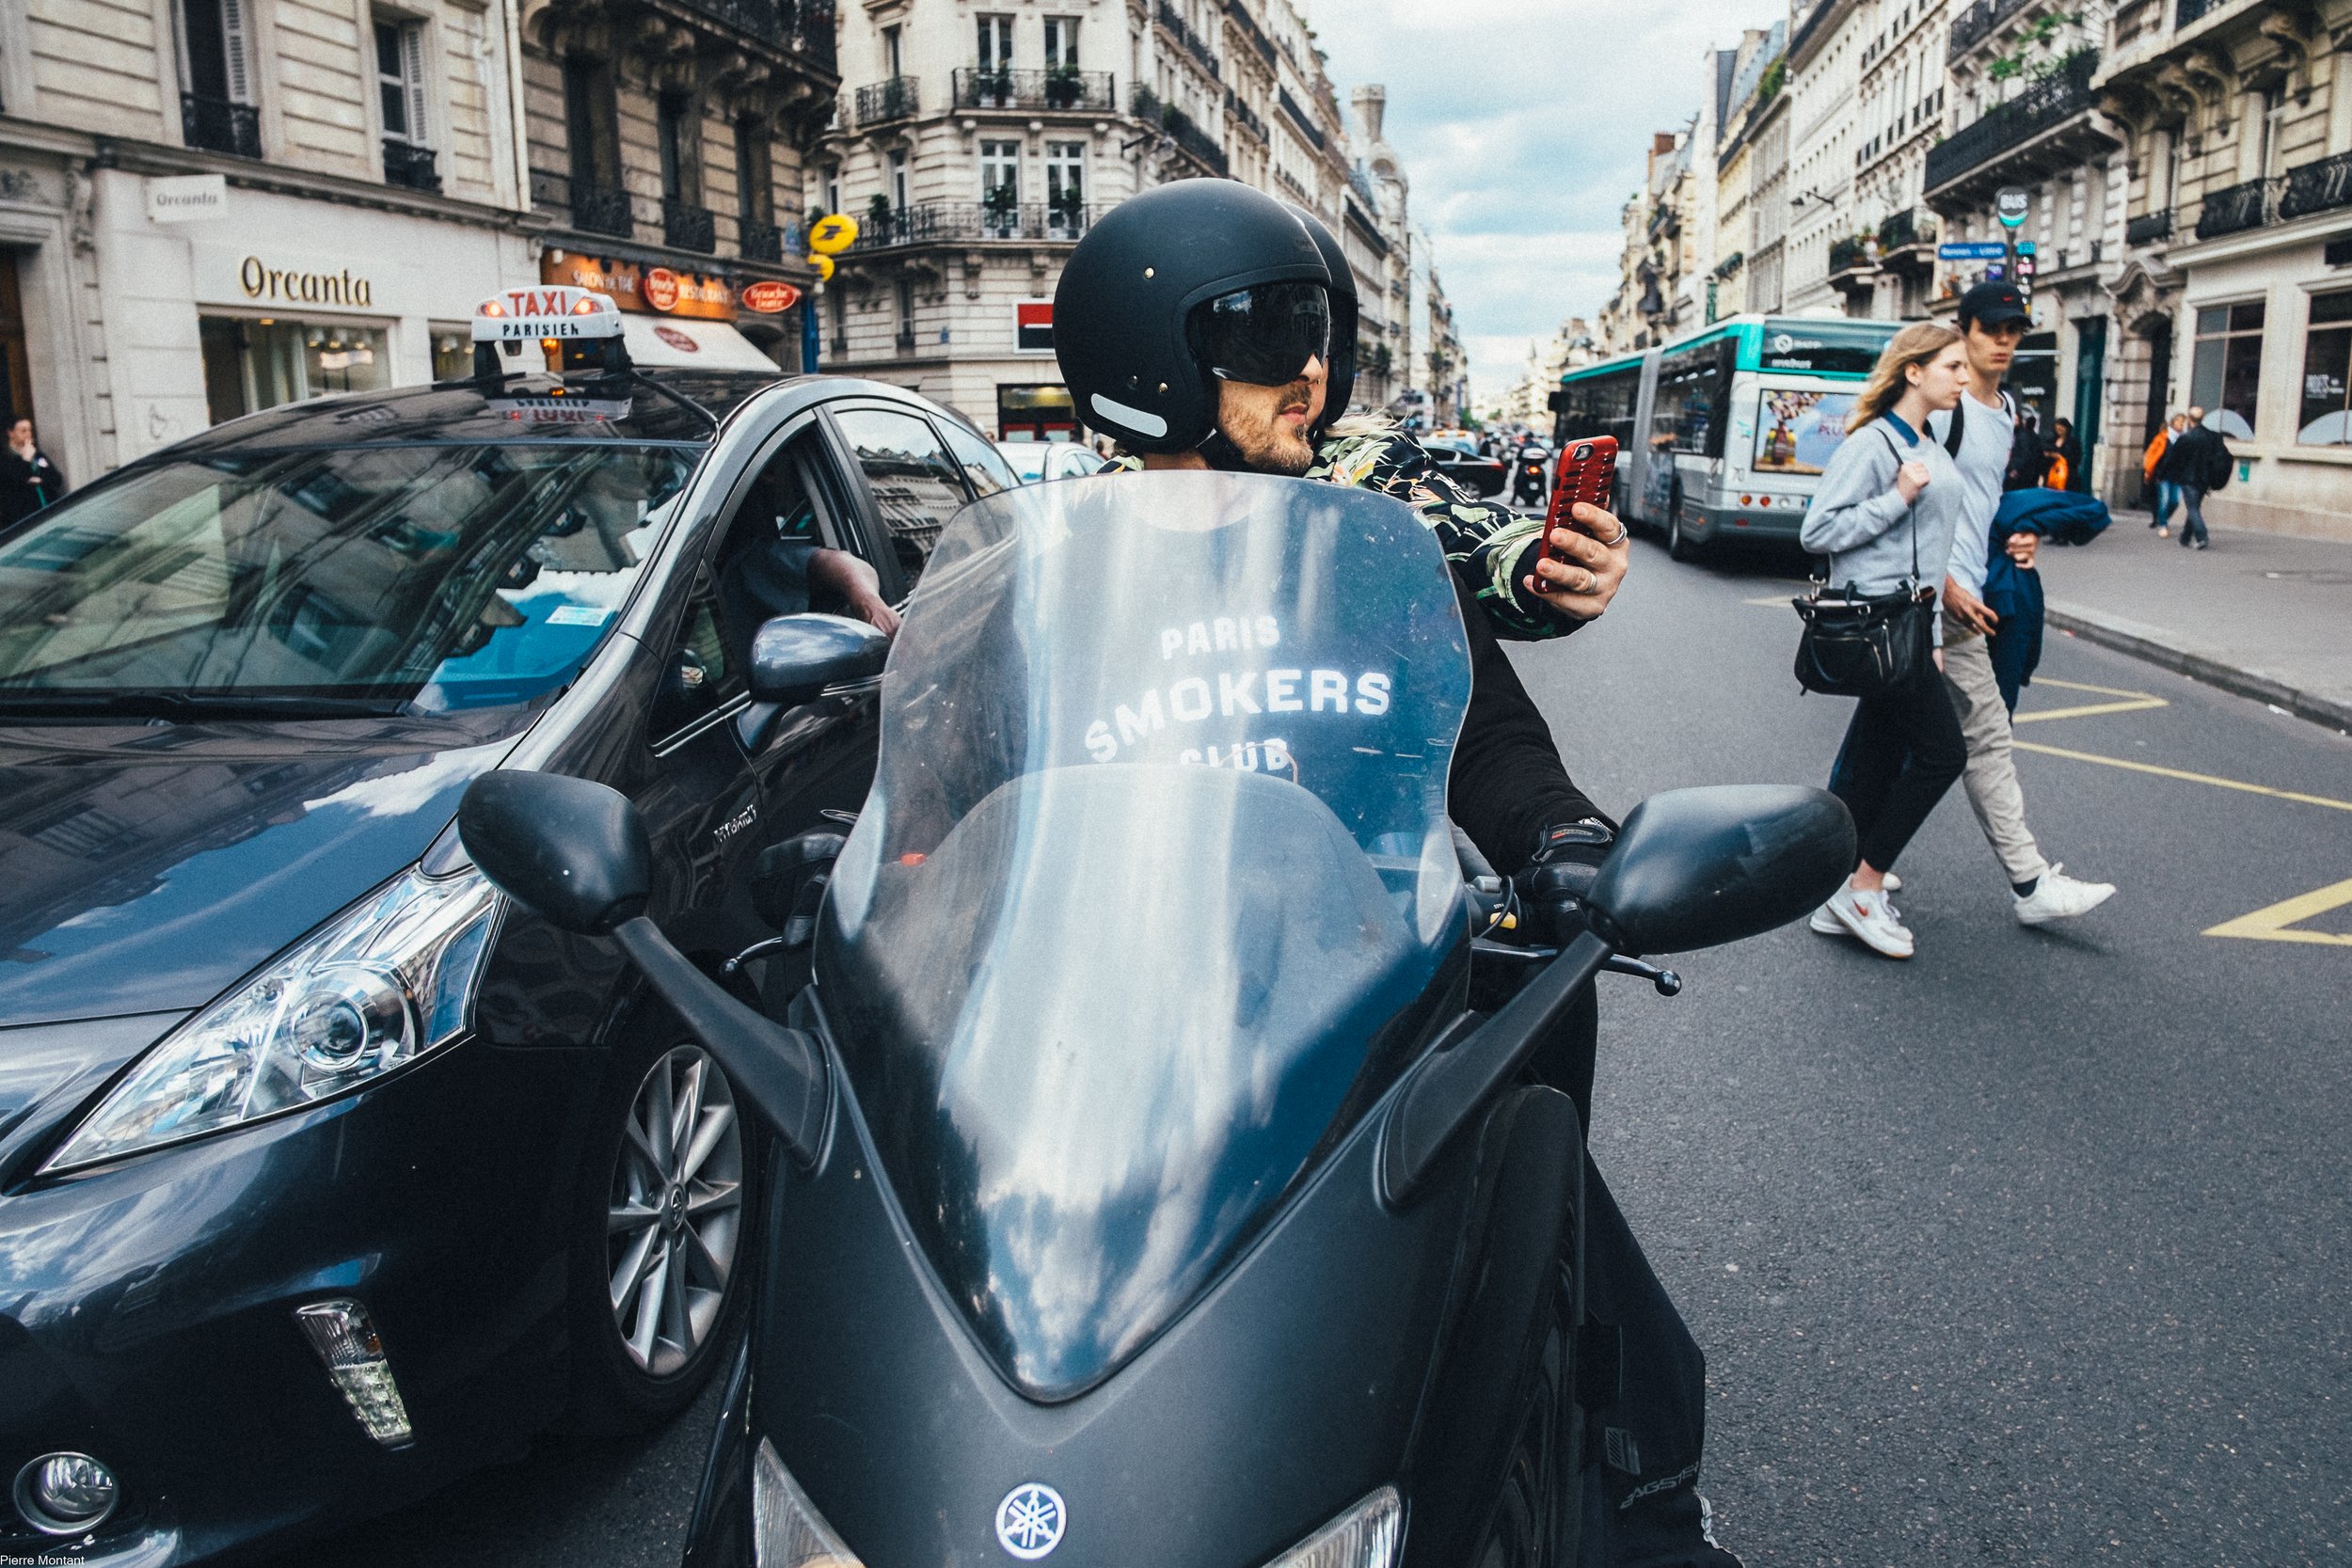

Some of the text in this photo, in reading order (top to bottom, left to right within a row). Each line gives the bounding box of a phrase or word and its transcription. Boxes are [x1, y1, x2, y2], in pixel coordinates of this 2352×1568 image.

[156, 192, 217, 206] Orcanta
[1999, 194, 2027, 209] BUS
[1941, 247, 1972, 256] Rennes
[241, 256, 373, 307] Orcanta
[573, 270, 604, 288] SALON
[507, 292, 567, 316] TAXI
[503, 324, 579, 337] PARISIEN
[1160, 616, 1280, 659] PARIS
[1084, 669, 1391, 763] SMOKERS
